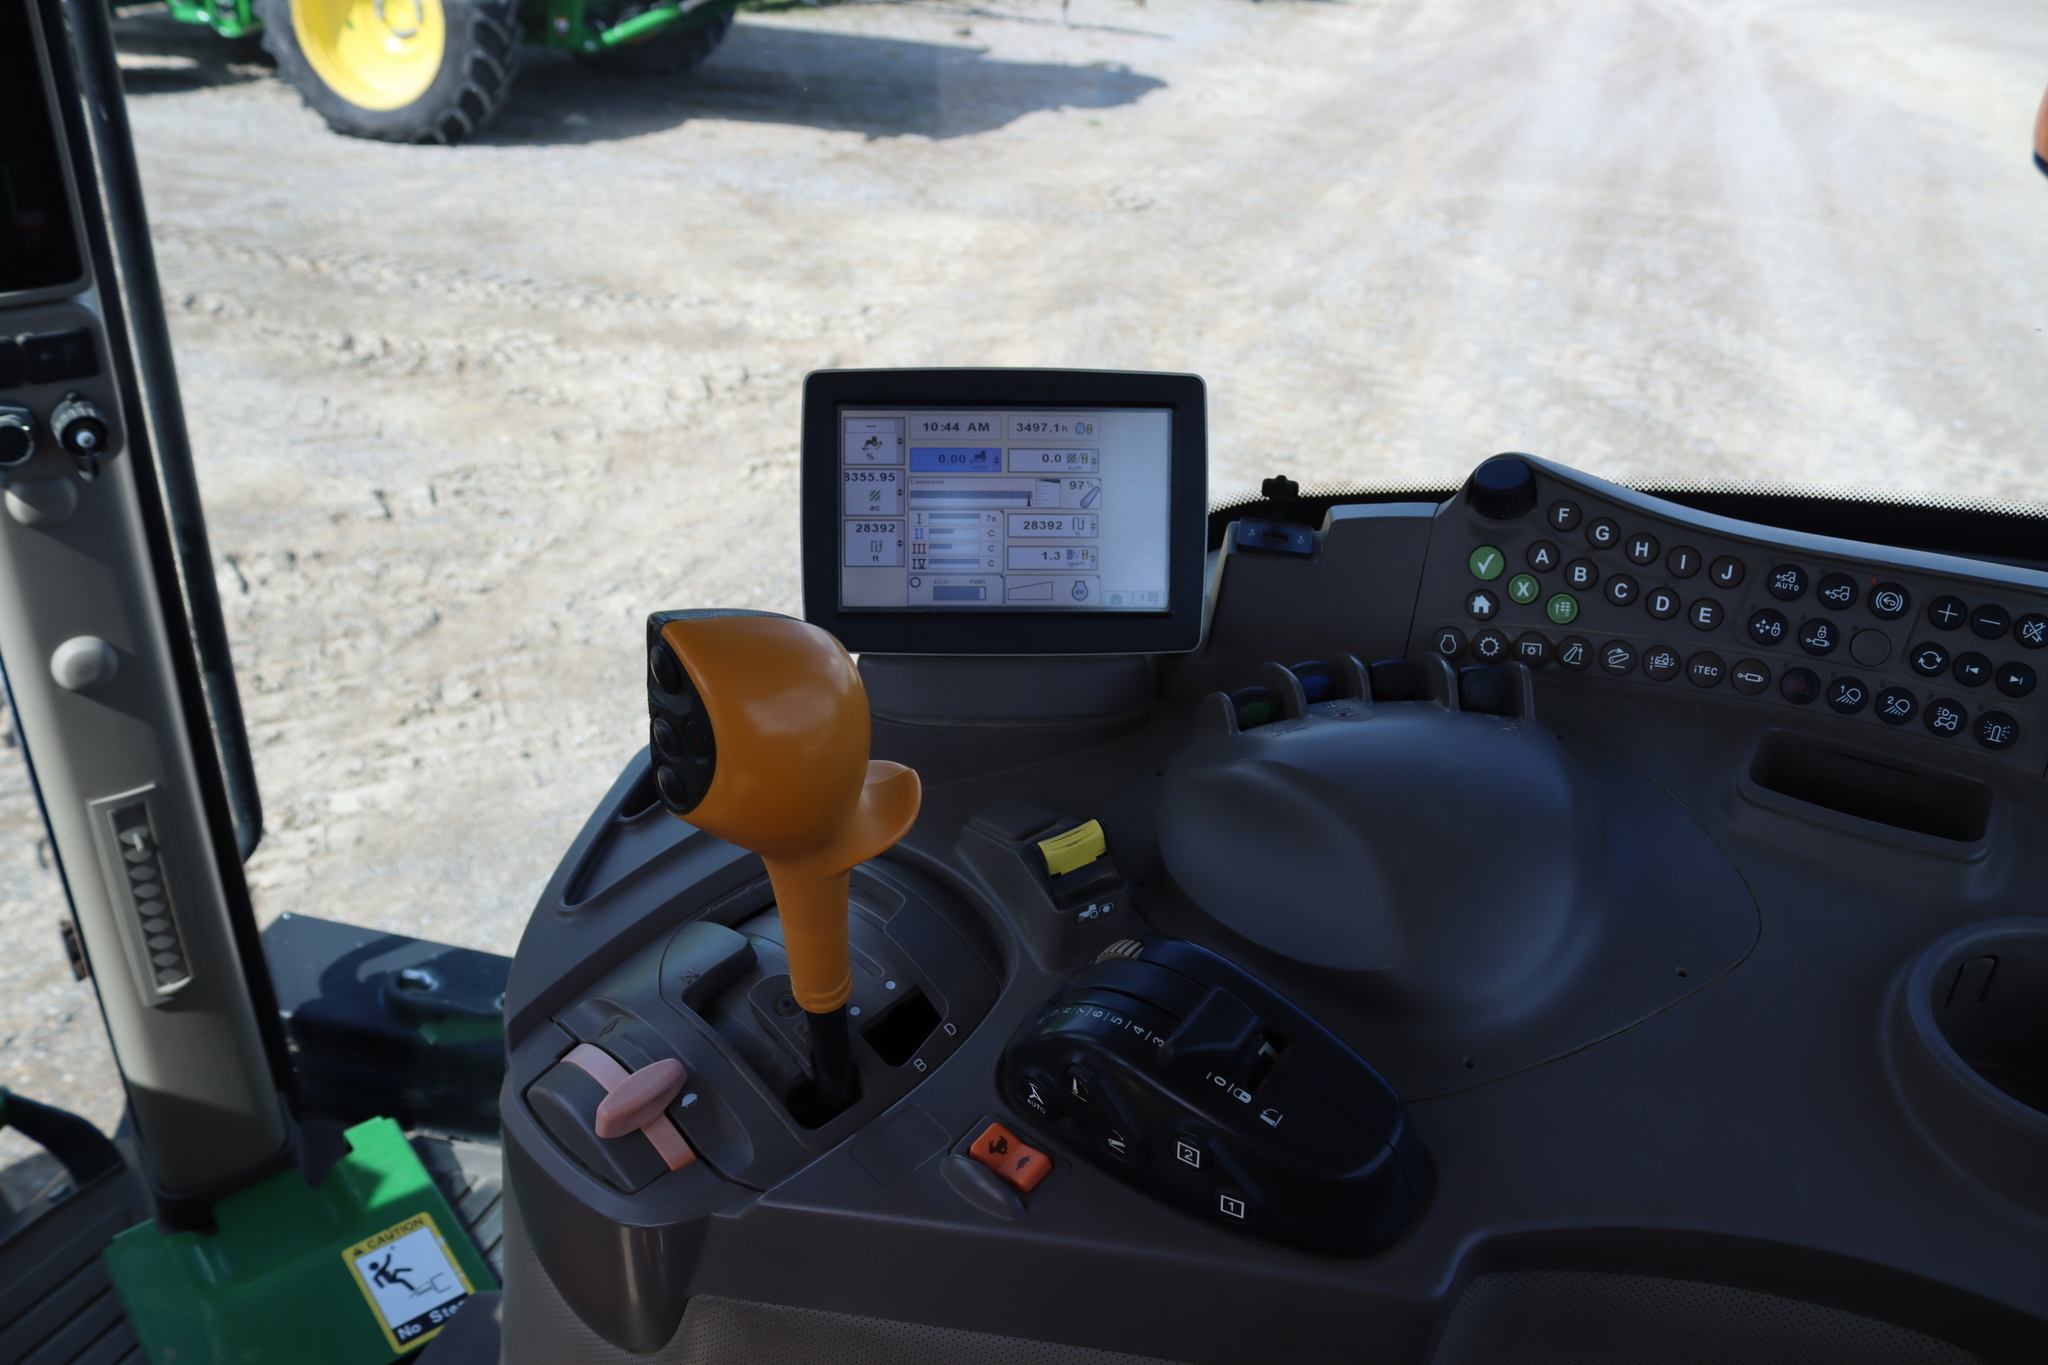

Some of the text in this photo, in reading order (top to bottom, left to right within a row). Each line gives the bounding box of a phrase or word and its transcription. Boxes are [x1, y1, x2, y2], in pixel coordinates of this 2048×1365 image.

[923, 422, 990, 432] 10:44 AM
[1016, 423, 1059, 432] 3497.1
[938, 454, 966, 464] 0.00
[1042, 454, 1062, 463] 0.0
[1069, 480, 1085, 490] 97
[1558, 508, 1570, 522] F
[855, 523, 896, 533] 28392
[1023, 521, 1063, 530] 28392
[914, 528, 925, 540] II
[987, 530, 995, 538] C
[1595, 526, 1610, 541] G
[912, 543, 927, 555] III
[1635, 542, 1649, 557] H
[1042, 551, 1061, 561] 1.3
[1535, 549, 1549, 564] A
[1680, 554, 1686, 570] I
[912, 558, 927, 570] IV
[1573, 567, 1587, 582] B
[1721, 564, 1733, 580] J
[1516, 582, 1530, 597] X
[1614, 583, 1628, 598] C
[1775, 580, 1799, 592] AUTO
[1655, 596, 1670, 612] D
[1699, 607, 1712, 623] E
[1694, 665, 1718, 677] iTEC
[1840, 685, 1845, 693] 1
[1887, 696, 1894, 705] 2
[1110, 1016, 1123, 1025] 5
[943, 1023, 957, 1035] D
[1133, 1025, 1145, 1035] 4
[1152, 1037, 1164, 1048] 3
[913, 1058, 927, 1072] B
[1027, 1098, 1046, 1114] AUTO
[1184, 1149, 1193, 1162] 2
[366, 1218, 423, 1249] CAUTION
[397, 1322, 422, 1340] No
